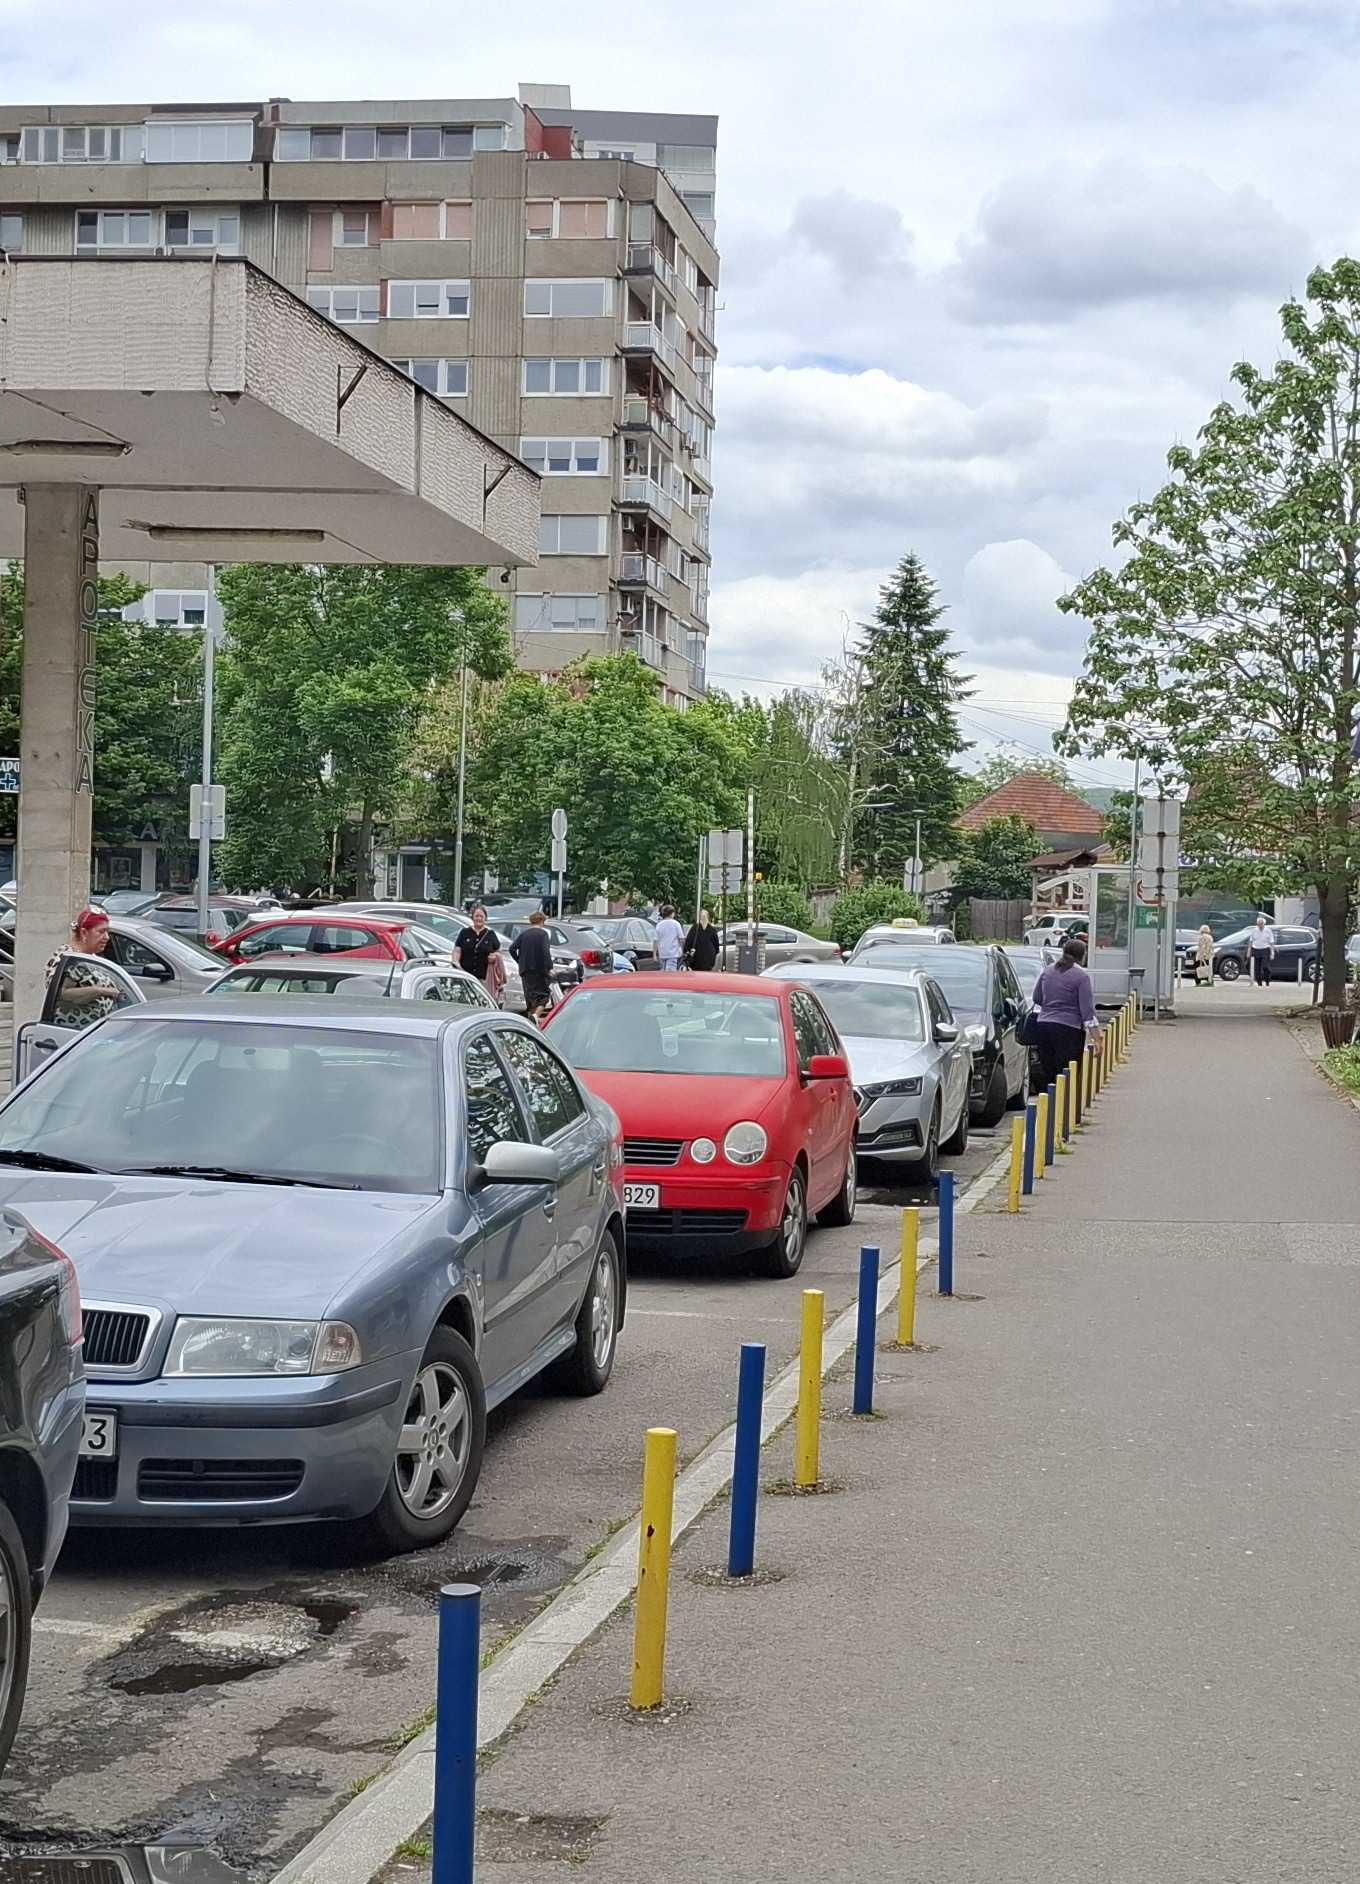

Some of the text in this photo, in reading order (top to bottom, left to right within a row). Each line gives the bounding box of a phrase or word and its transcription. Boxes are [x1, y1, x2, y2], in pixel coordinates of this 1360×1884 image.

[76, 493, 100, 797] APOTEKA
[624, 1186, 656, 1205] 829
[81, 1417, 108, 1450] 3
